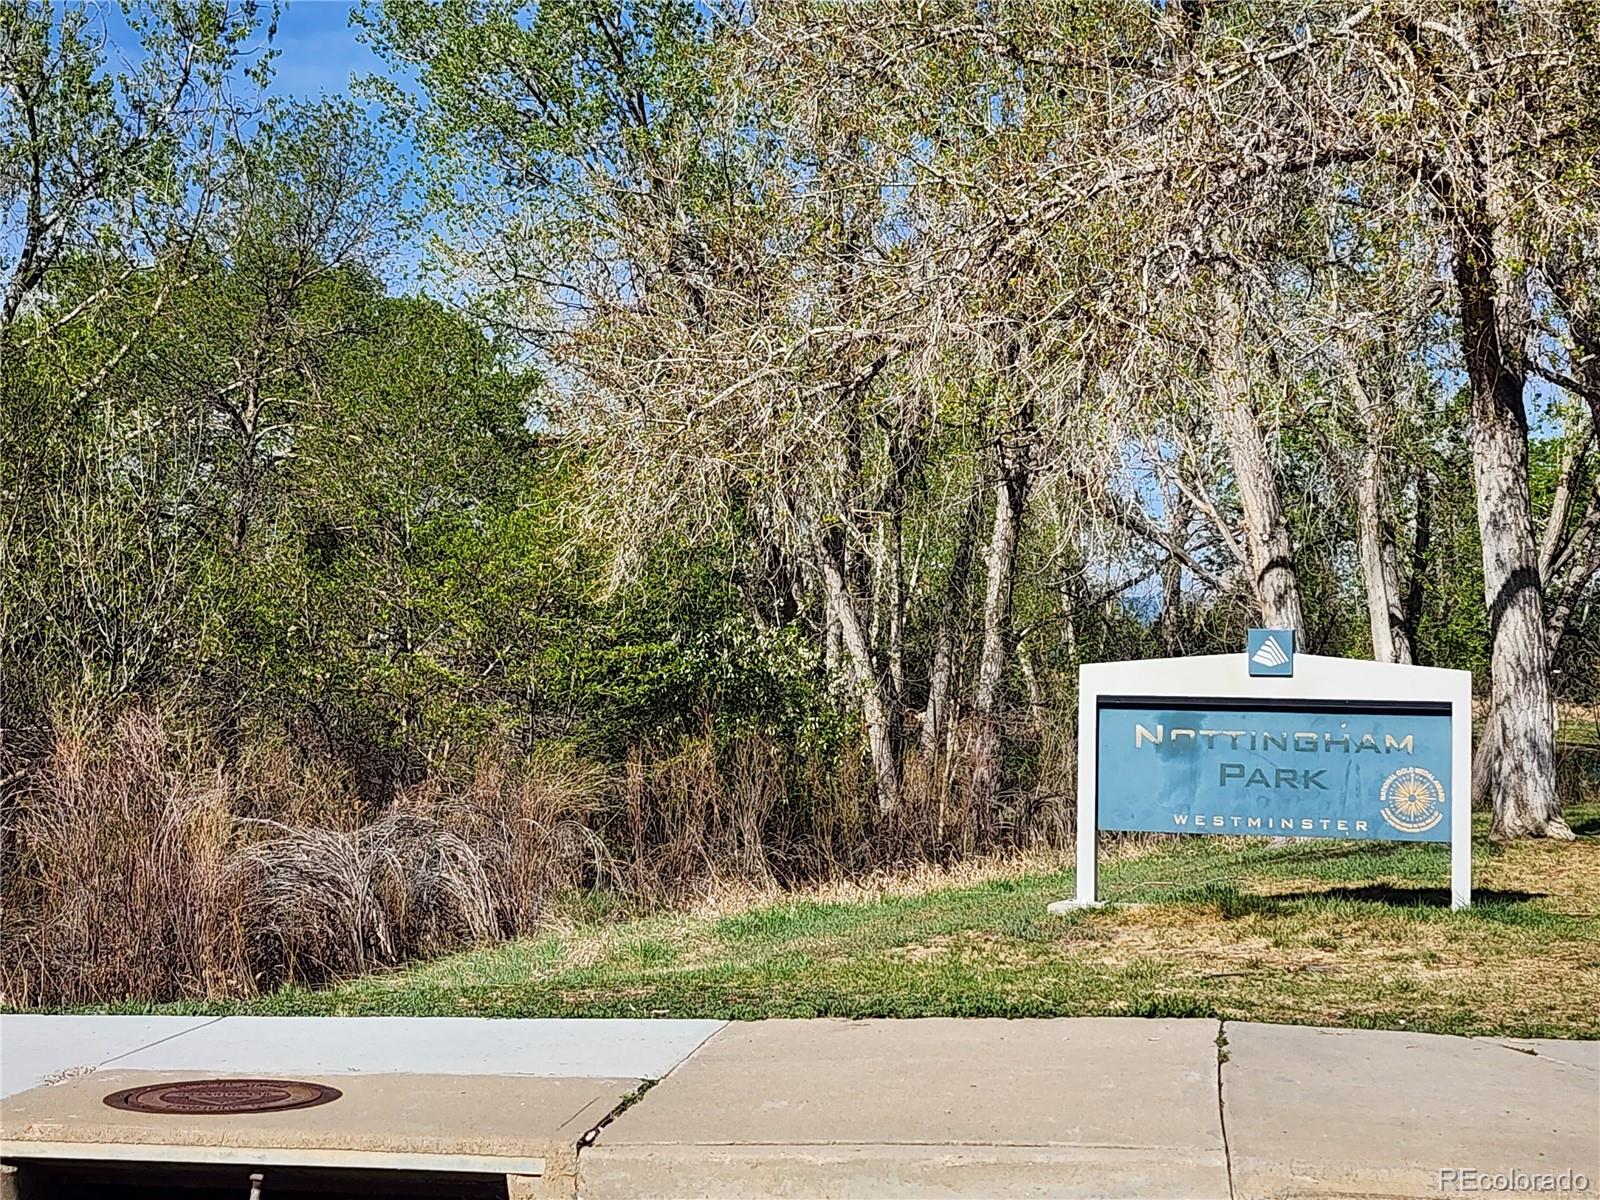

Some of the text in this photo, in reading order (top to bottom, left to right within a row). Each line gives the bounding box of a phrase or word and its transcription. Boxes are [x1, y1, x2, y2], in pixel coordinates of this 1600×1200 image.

[1219, 763, 1329, 791] PARK
[1380, 774, 1397, 801] NATIONAL
[1396, 767, 1414, 776] GOLD
[1173, 814, 1369, 832] WESTMINSTER
